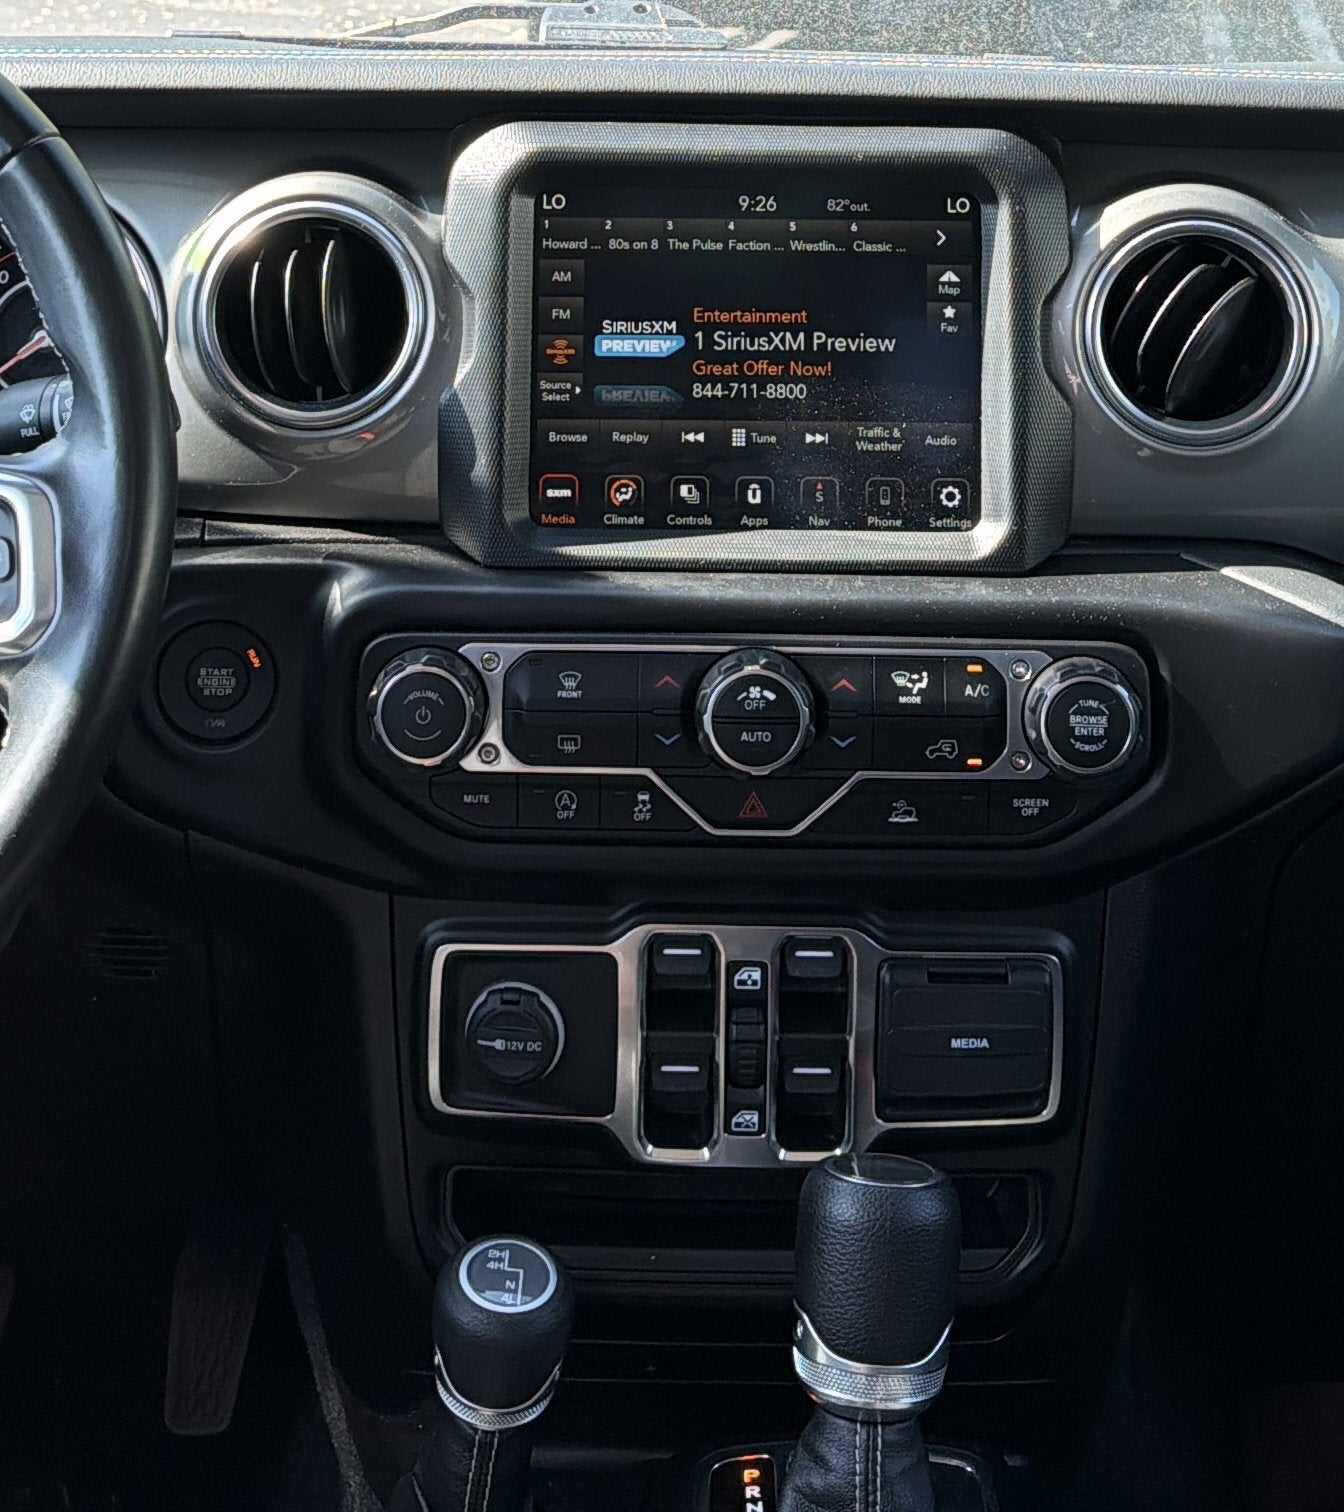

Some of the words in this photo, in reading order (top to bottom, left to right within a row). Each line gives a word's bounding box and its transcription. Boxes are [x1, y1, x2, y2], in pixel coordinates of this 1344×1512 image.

[542, 194, 566, 209] LO
[739, 195, 777, 211] 9:26
[946, 197, 970, 213] LO
[604, 220, 613, 230] 2
[666, 220, 674, 230] 3
[727, 221, 736, 231] 4
[788, 221, 797, 232] 5
[850, 222, 859, 232] 6
[542, 238, 588, 250] Howard
[609, 238, 630, 250] 80s
[632, 241, 648, 250] on
[650, 238, 659, 250] 8
[667, 238, 690, 251] The
[692, 239, 724, 251] Pulse
[728, 239, 771, 251] Faction
[853, 240, 893, 252] Classic
[551, 271, 572, 282] AM
[938, 285, 961, 296] Map
[551, 308, 571, 320] FM
[693, 307, 809, 324] Entertainment
[940, 322, 959, 333] Fav
[601, 340, 679, 353] PREVIEW
[693, 331, 704, 351] 1
[712, 330, 806, 352] SiriusXM
[812, 332, 898, 352] Preview
[692, 360, 739, 376] Great
[743, 360, 785, 376] Offer
[789, 361, 832, 377] Now!
[539, 379, 572, 390] Source
[541, 391, 571, 402] Select
[692, 382, 807, 400] 844-711-8800
[20, 426, 40, 438] PULL
[548, 431, 589, 443] Browse
[612, 431, 650, 445] Replay
[750, 432, 778, 444] Tune
[856, 426, 889, 438] Traffic
[891, 426, 901, 438] &
[855, 440, 903, 452] Weather
[924, 435, 958, 447] Audio
[541, 513, 576, 525] Media
[603, 513, 645, 526] Climate
[666, 514, 713, 526] Controls
[740, 514, 769, 529] Apps
[807, 515, 831, 527] Nav
[867, 516, 904, 528] Phone
[928, 516, 973, 529] Settings
[199, 667, 235, 676] START
[197, 677, 237, 686] ENGINE
[203, 688, 233, 696] STOP
[407, 688, 441, 702] VOLUME
[557, 690, 583, 699] FRONT
[964, 684, 990, 697] A/C
[744, 699, 766, 711] OFF
[898, 695, 922, 704] MODE
[1077, 698, 1100, 710] TUNE
[1069, 714, 1108, 724] BROWSE
[740, 731, 772, 743] AUTO
[1074, 726, 1105, 737] ENTER
[1074, 740, 1105, 752] SCROLL
[463, 793, 490, 804] MUTE
[1012, 798, 1049, 808] SCREEN
[556, 809, 575, 820] OFF
[633, 811, 652, 822] OFF
[1021, 807, 1040, 817] OFF
[505, 1039, 525, 1052] 12V
[526, 1039, 543, 1052] DC
[950, 1037, 990, 1049] MEDIA
[487, 1248, 506, 1259] 2H
[485, 1260, 504, 1270] 4H
[505, 1279, 516, 1290] N
[500, 1292, 516, 1305] 4L
[743, 1468, 761, 1484] P
[745, 1485, 762, 1499] R
